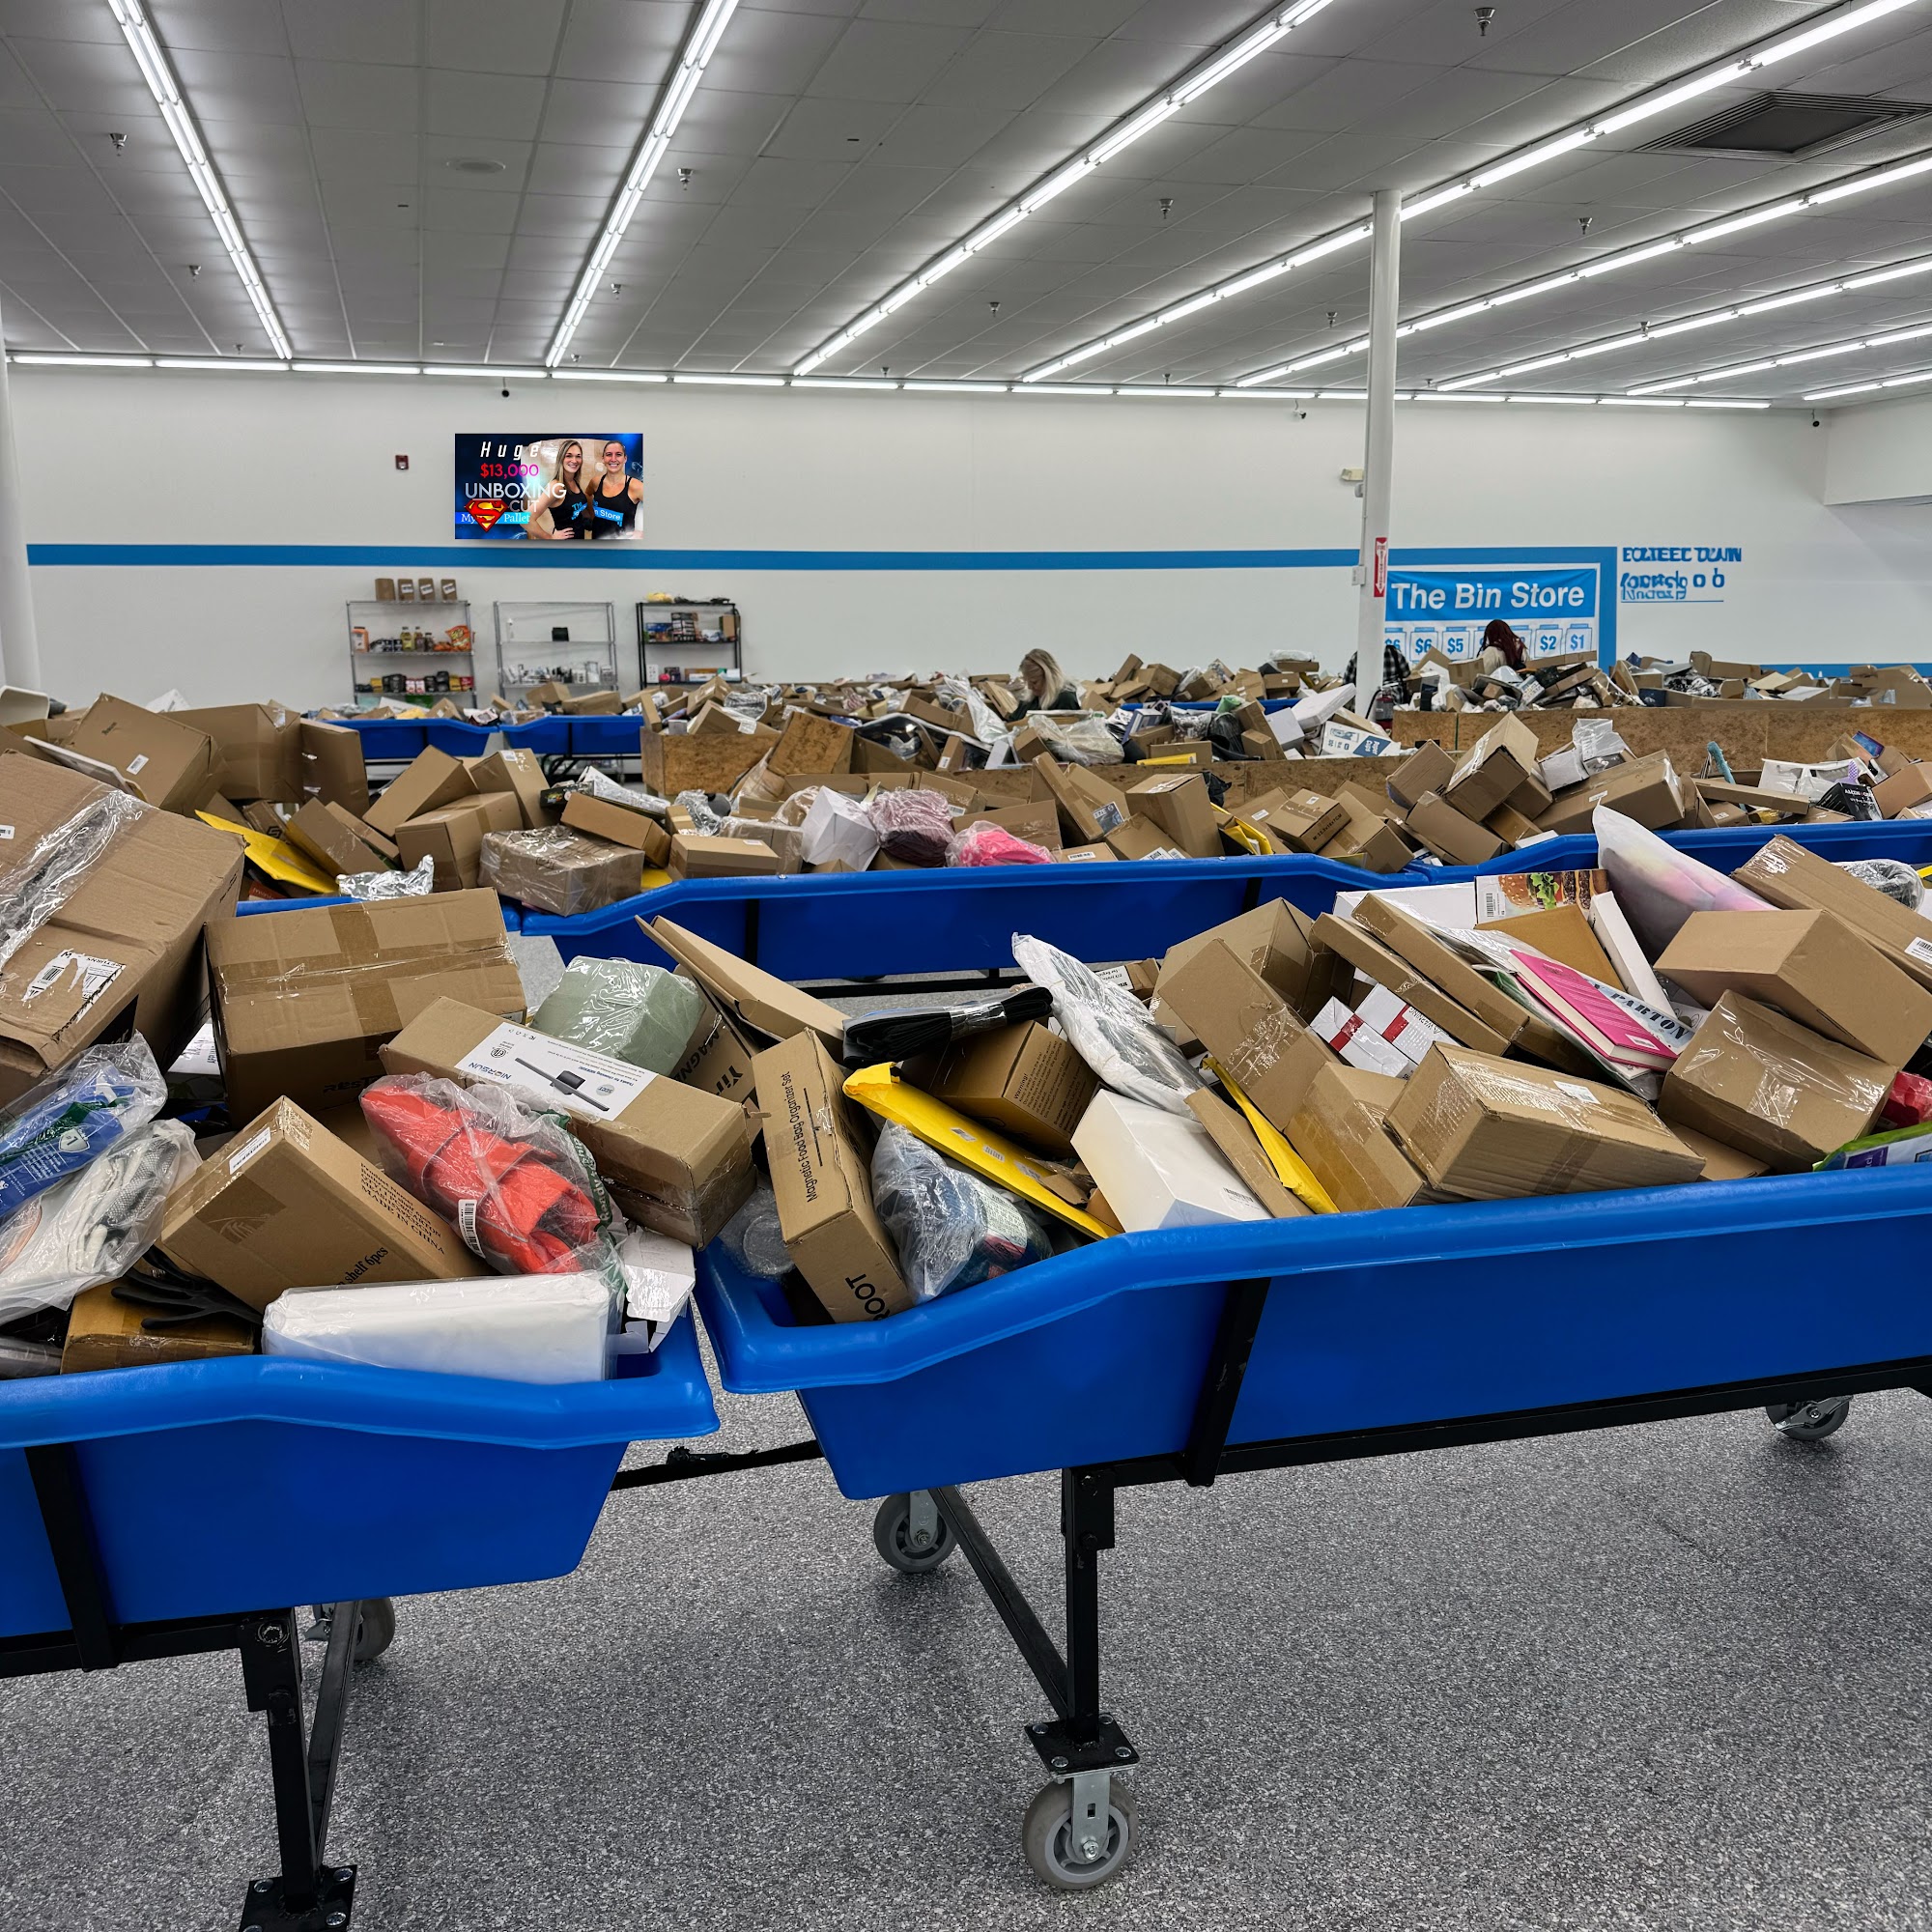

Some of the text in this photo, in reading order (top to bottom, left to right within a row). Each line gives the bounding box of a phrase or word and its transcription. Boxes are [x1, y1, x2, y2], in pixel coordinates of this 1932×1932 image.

[480, 441, 540, 461] Huge
[479, 464, 539, 478] $13,000
[465, 482, 567, 499] UNBOXING
[503, 512, 531, 524] Pallet
[1391, 582, 1585, 610] The Bin Store
[1447, 638, 1463, 654] $5
[1540, 635, 1557, 652] $2
[1571, 634, 1584, 650] $1
[1611, 993, 1689, 1038] PARTON
[1012, 1072, 1029, 1099] Warning!
[781, 1071, 816, 1202] Magnetic Food Bag Organizer Set
[361, 1184, 444, 1255] MADE IN CHINA
[342, 1246, 388, 1284] shelf 6pcs
